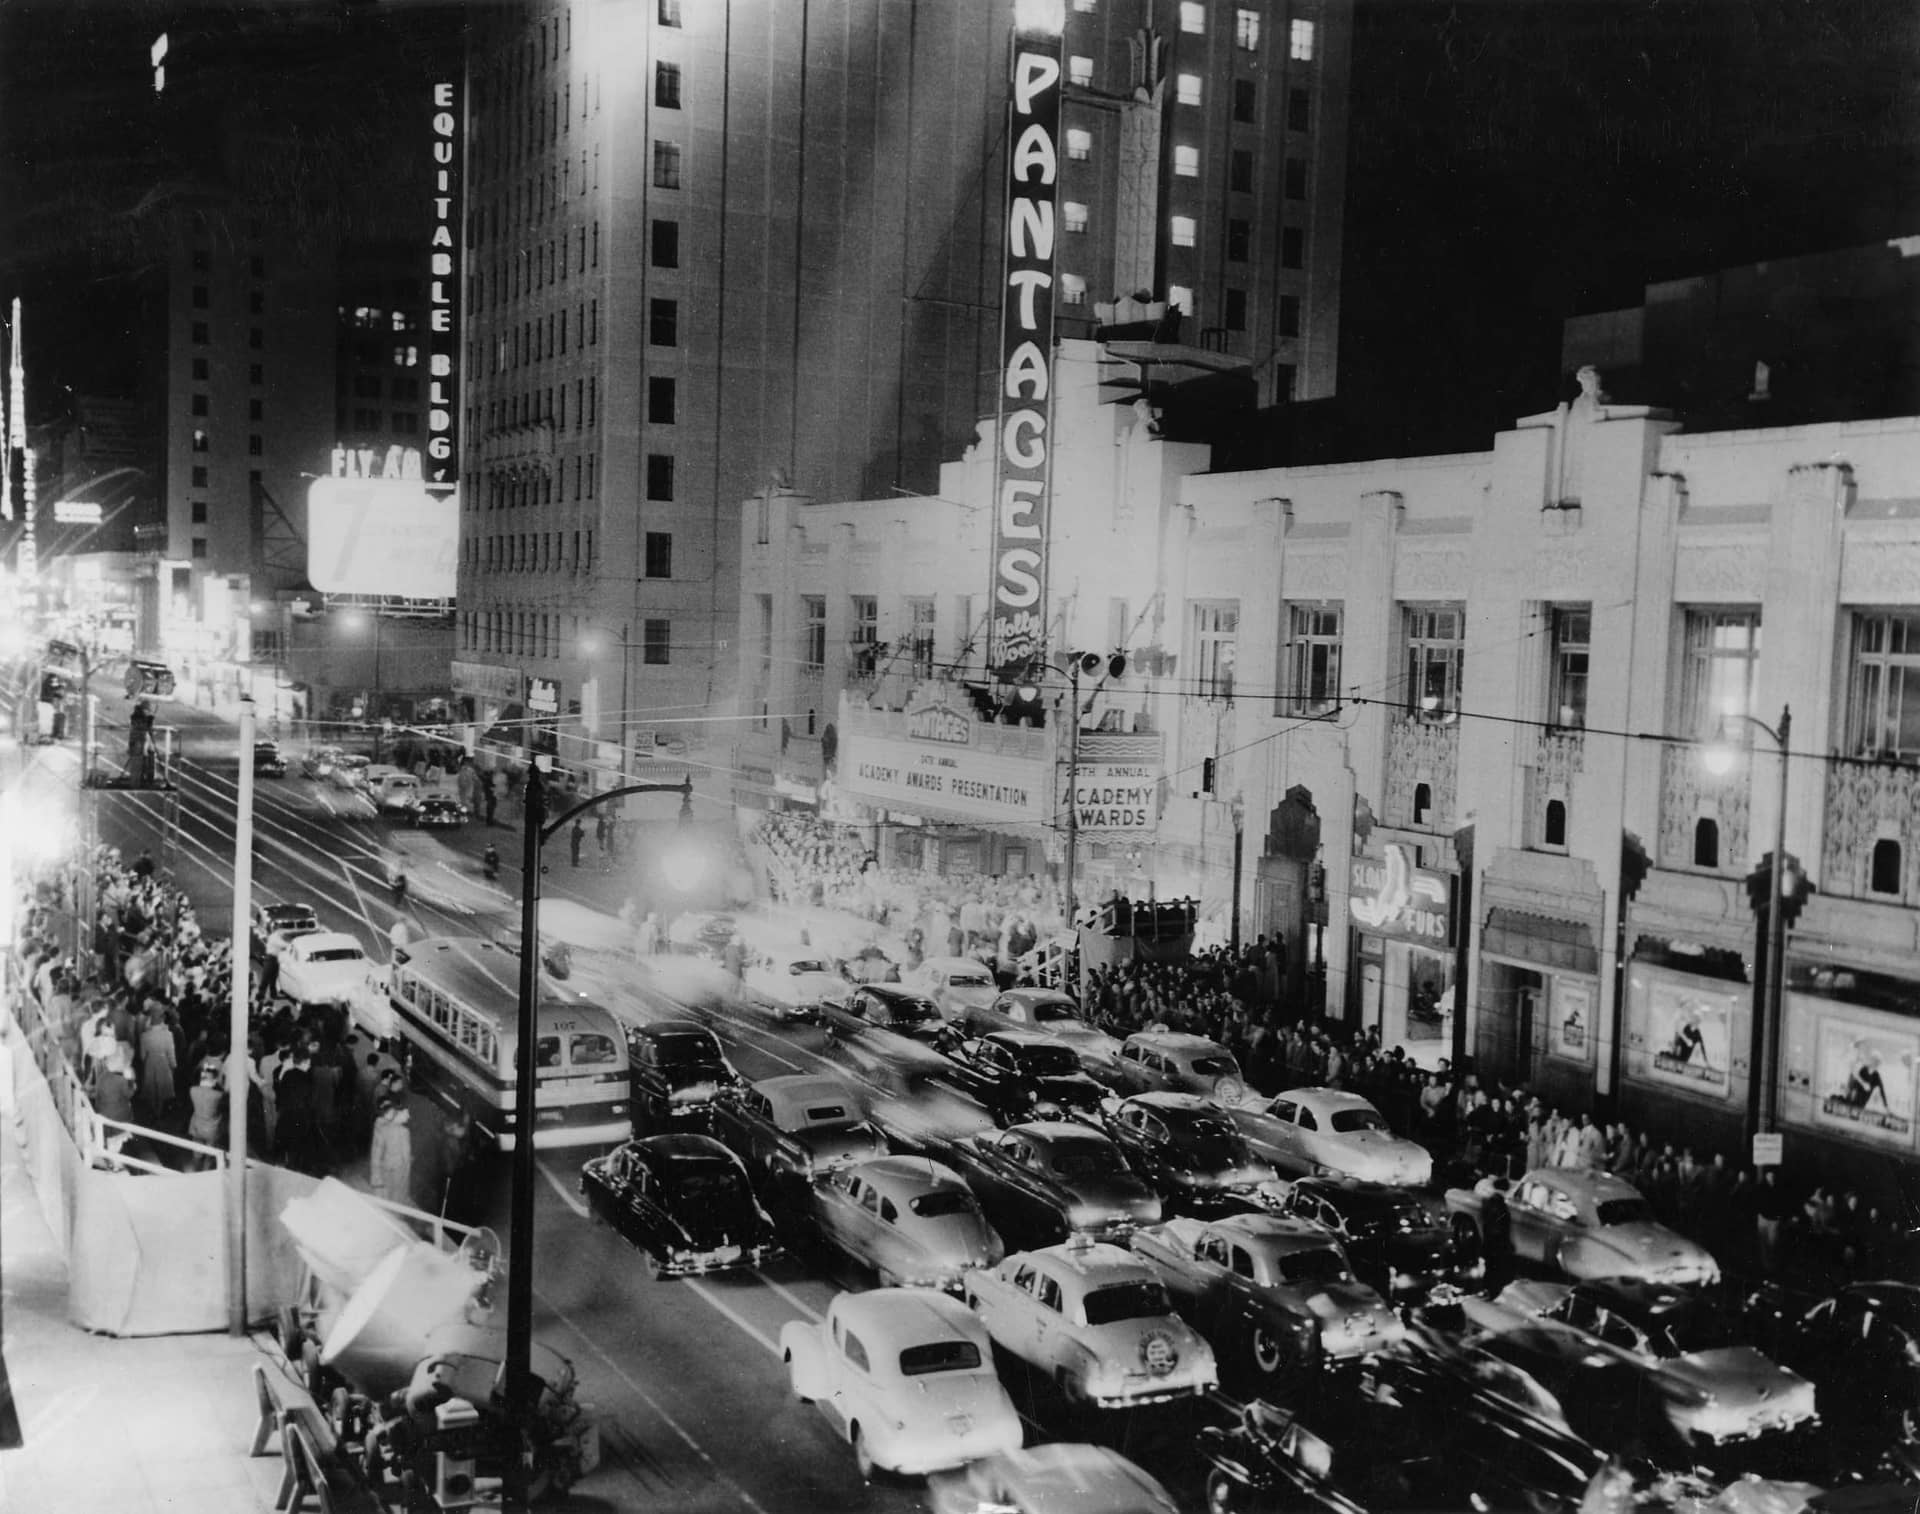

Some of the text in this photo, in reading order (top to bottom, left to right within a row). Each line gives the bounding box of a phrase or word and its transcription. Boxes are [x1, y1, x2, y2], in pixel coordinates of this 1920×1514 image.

[429, 83, 455, 459] EQUITABLE BLDG
[996, 51, 1059, 607] PANTAGES
[331, 448, 374, 479] FLY
[858, 763, 1028, 807] ACADEMY AWARDS PRESENTATION
[1107, 766, 1151, 778] ANNUAL
[1061, 787, 1153, 806] ACADEMY
[1403, 908, 1445, 938] FURS
